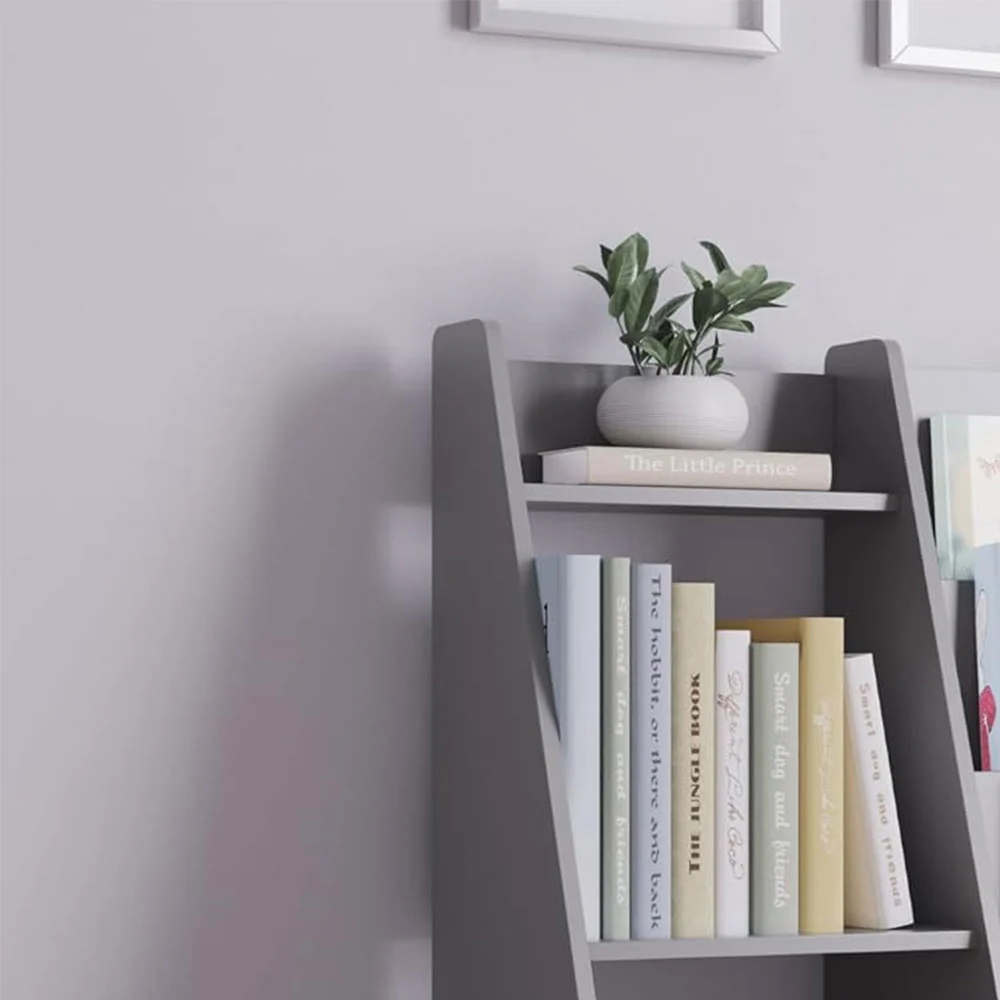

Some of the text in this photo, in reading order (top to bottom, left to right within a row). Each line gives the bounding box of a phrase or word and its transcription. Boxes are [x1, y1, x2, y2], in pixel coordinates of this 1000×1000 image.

[624, 454, 798, 477] The Little Prince
[650, 573, 662, 619] The
[690, 672, 701, 737] BOOK
[858, 682, 877, 737] Smart
[689, 745, 701, 821] JUNGLE
[766, 671, 792, 909] Smart dog and friends
[650, 816, 660, 865] and
[650, 873, 661, 929] back
